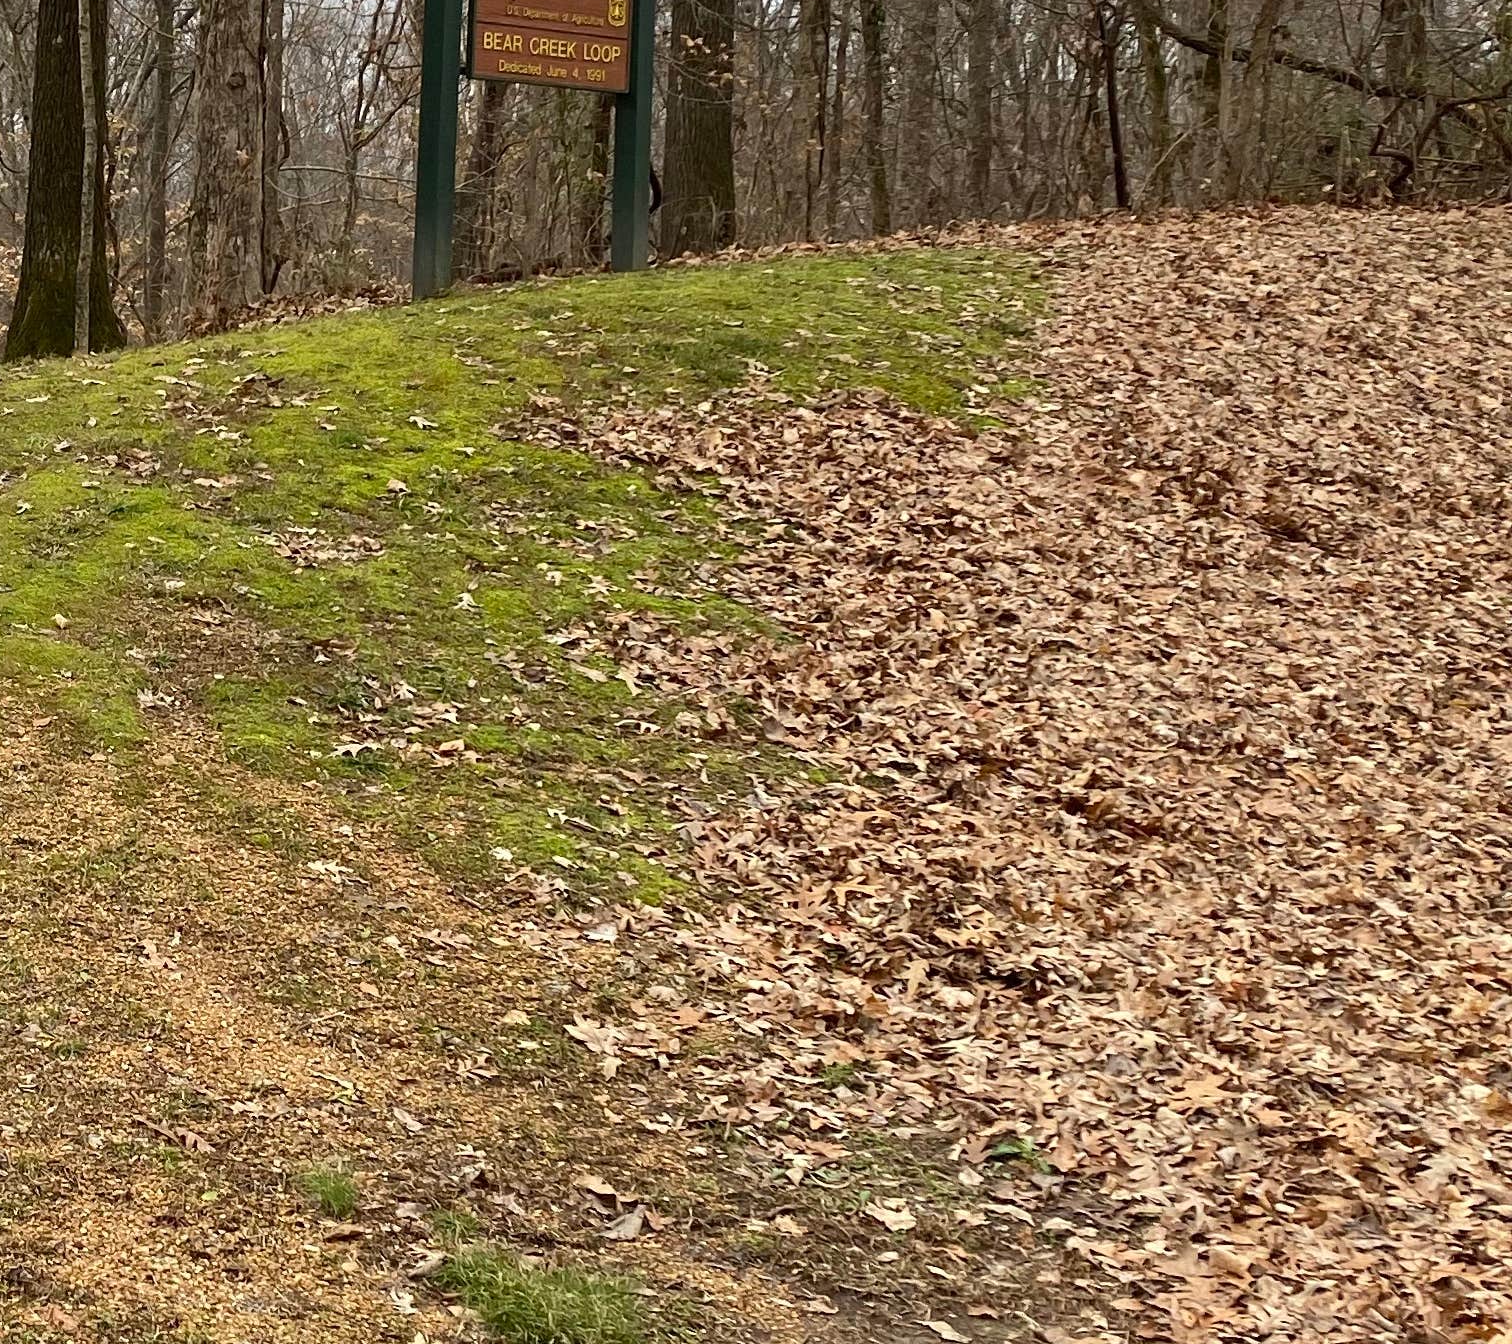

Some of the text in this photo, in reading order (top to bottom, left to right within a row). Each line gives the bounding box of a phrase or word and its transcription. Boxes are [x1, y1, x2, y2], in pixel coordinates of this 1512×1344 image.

[483, 31, 621, 63] BEAR CREEK LOOP
[498, 59, 542, 76] Dedicated
[546, 65, 568, 78] June
[586, 69, 606, 82] 1991
